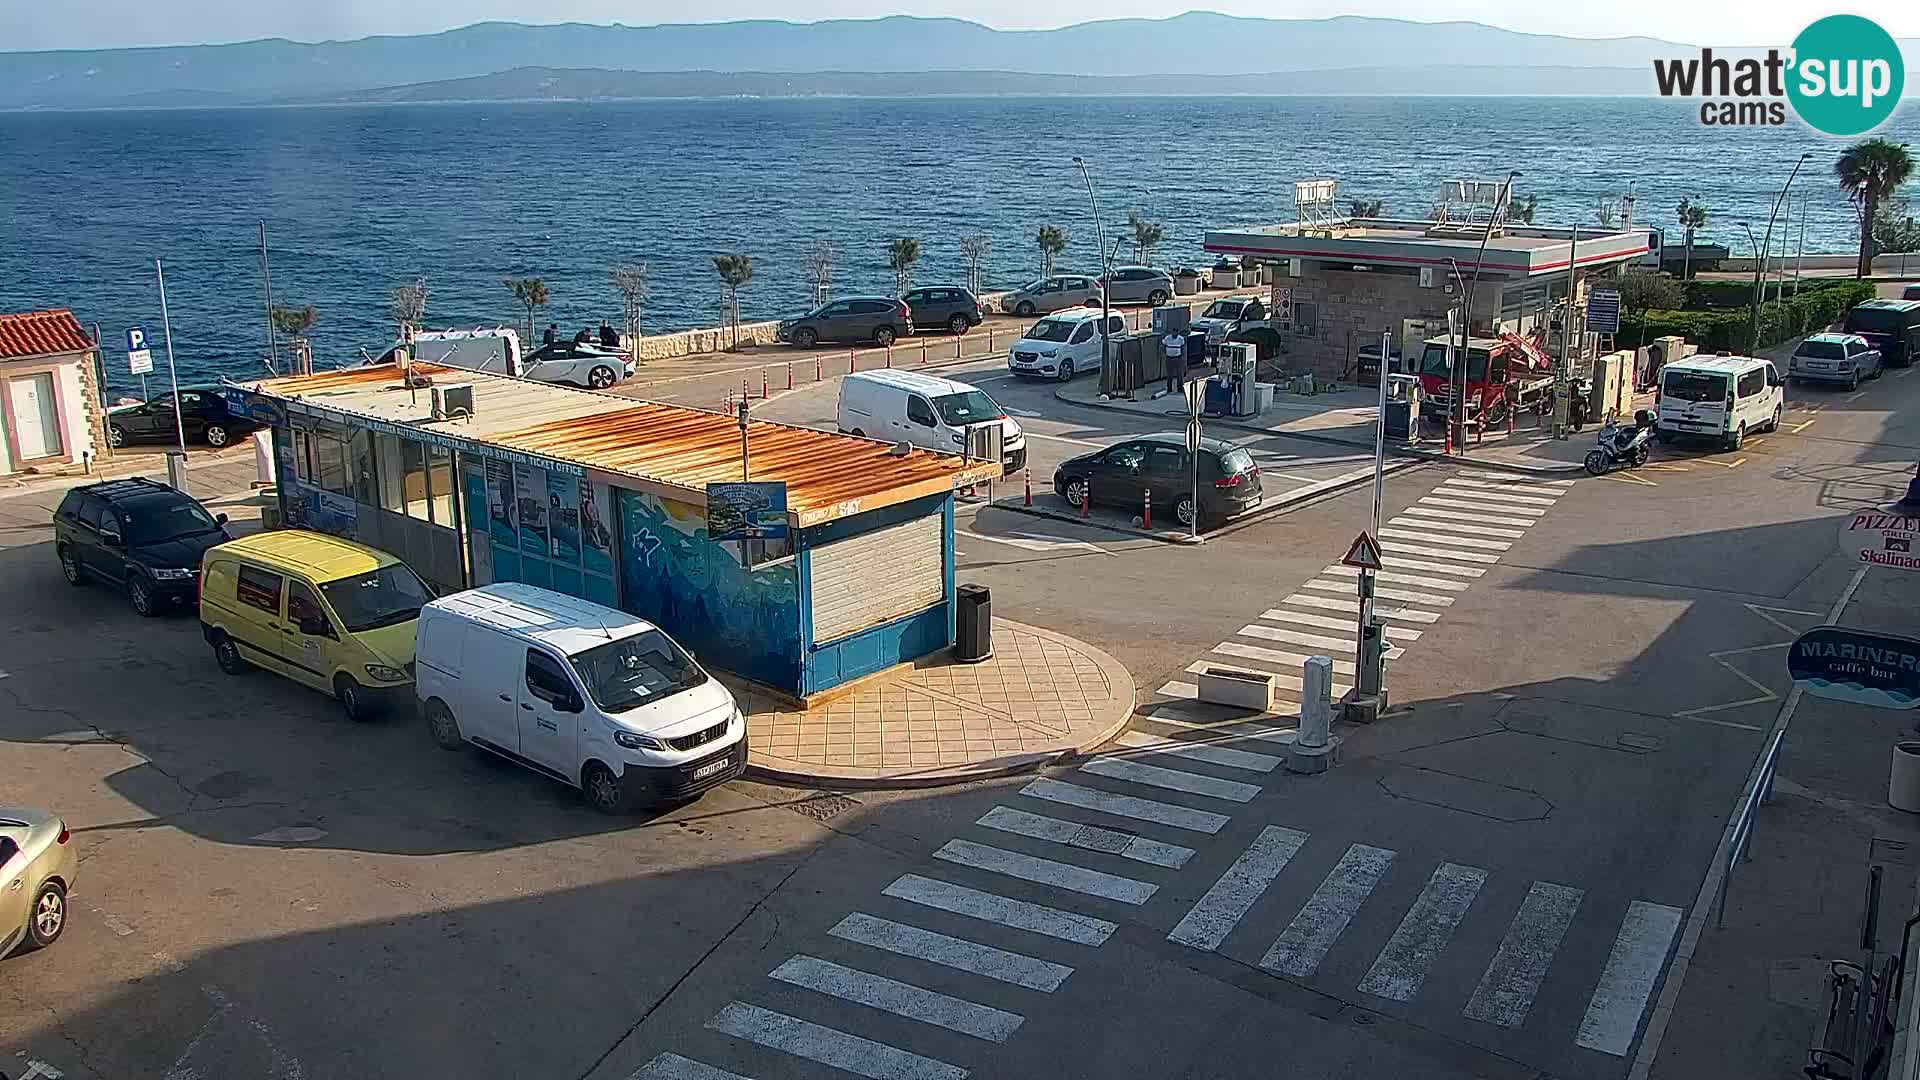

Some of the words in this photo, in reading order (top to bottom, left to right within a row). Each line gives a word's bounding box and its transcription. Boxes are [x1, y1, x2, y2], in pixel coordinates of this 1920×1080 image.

[130, 331, 144, 350] P
[479, 447, 494, 457] BUS
[495, 449, 527, 465] STATION
[529, 456, 555, 471] TICKET
[556, 462, 583, 477] OFFICE
[1848, 515, 1920, 533] PIZZE
[1870, 665, 1897, 680] bar
